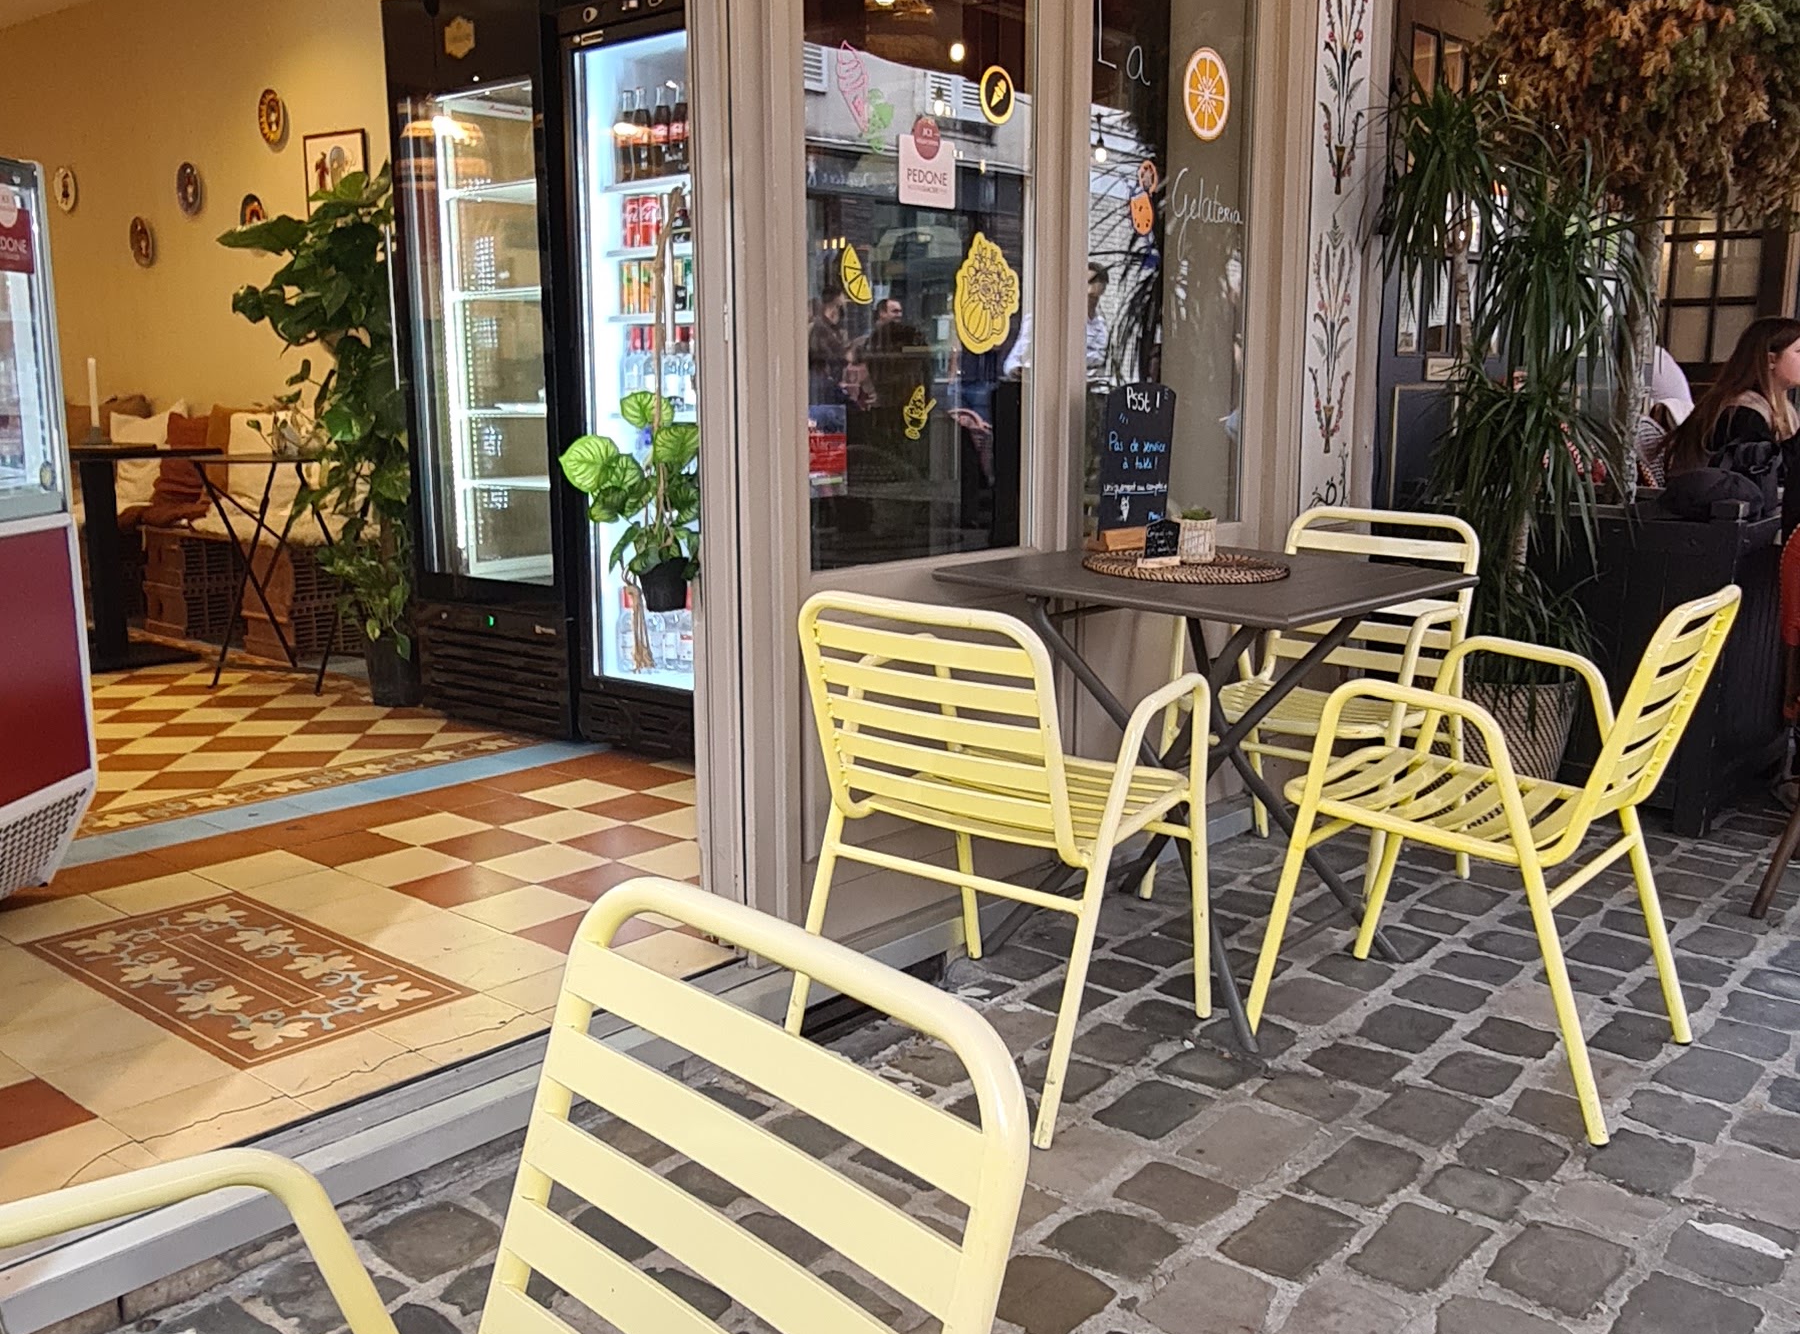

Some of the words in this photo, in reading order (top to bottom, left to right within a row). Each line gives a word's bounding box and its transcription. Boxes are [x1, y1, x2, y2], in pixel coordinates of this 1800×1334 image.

[907, 168, 948, 186] PEDONE
[1172, 167, 1243, 262] Gelateria
[0, 236, 28, 255] DONE
[1126, 386, 1151, 414] Psst
[1109, 430, 1124, 452] Pas
[1130, 437, 1139, 453] de
